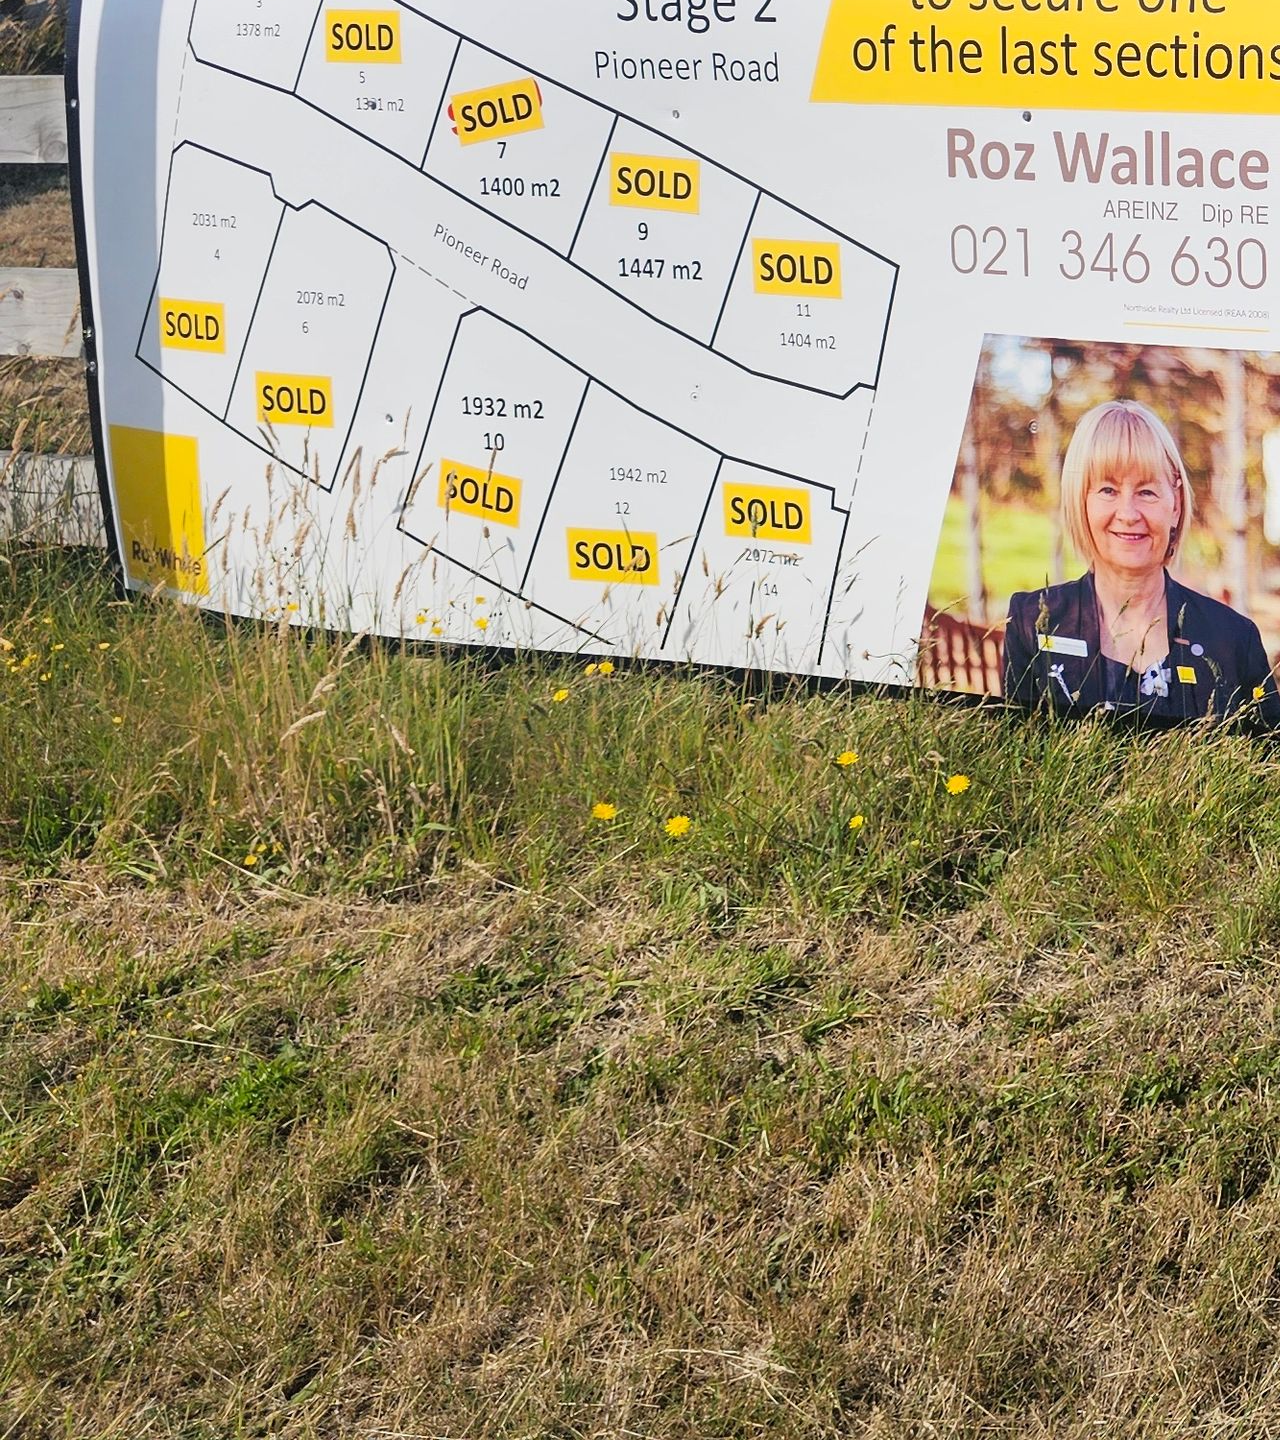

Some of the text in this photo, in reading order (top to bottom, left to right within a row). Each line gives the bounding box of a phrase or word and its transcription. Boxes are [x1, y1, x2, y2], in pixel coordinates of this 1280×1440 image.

[236, 24, 280, 37] 1378 m2
[331, 23, 394, 51] SOLD
[853, 24, 896, 72] of
[909, 25, 983, 74] the
[1001, 26, 1078, 76] last
[360, 71, 366, 83] 5
[594, 51, 780, 83] Pioneer Road
[387, 98, 405, 112] m2
[461, 94, 533, 132] SOLD
[497, 141, 507, 159] 7
[947, 128, 1270, 191] Roz Wallace
[480, 177, 561, 197] 1400 m2
[617, 167, 692, 200] SOLD
[192, 213, 237, 229] 2031 m2
[1103, 200, 1269, 228] AREINZ Dip RE
[638, 222, 649, 241] 9
[214, 249, 220, 260] 4
[434, 223, 529, 291] Pioneer Road
[951, 224, 1267, 290] 021 346 630
[618, 258, 703, 281] 1447 m2
[760, 253, 833, 285] SOLD
[296, 291, 346, 307] 2078 m2
[796, 304, 811, 317] 11
[165, 311, 220, 341] SOLD
[302, 321, 309, 334] 6
[780, 333, 836, 350] 1404 m2
[262, 385, 326, 415] SOLD
[461, 396, 545, 420] 1932 m2
[483, 432, 505, 451] 10
[609, 467, 668, 484] 1942 m2
[446, 472, 514, 514] SOLD
[615, 501, 630, 515] 12
[731, 497, 803, 530] SOLD
[575, 541, 651, 572] SOLD
[764, 583, 778, 596] 14
